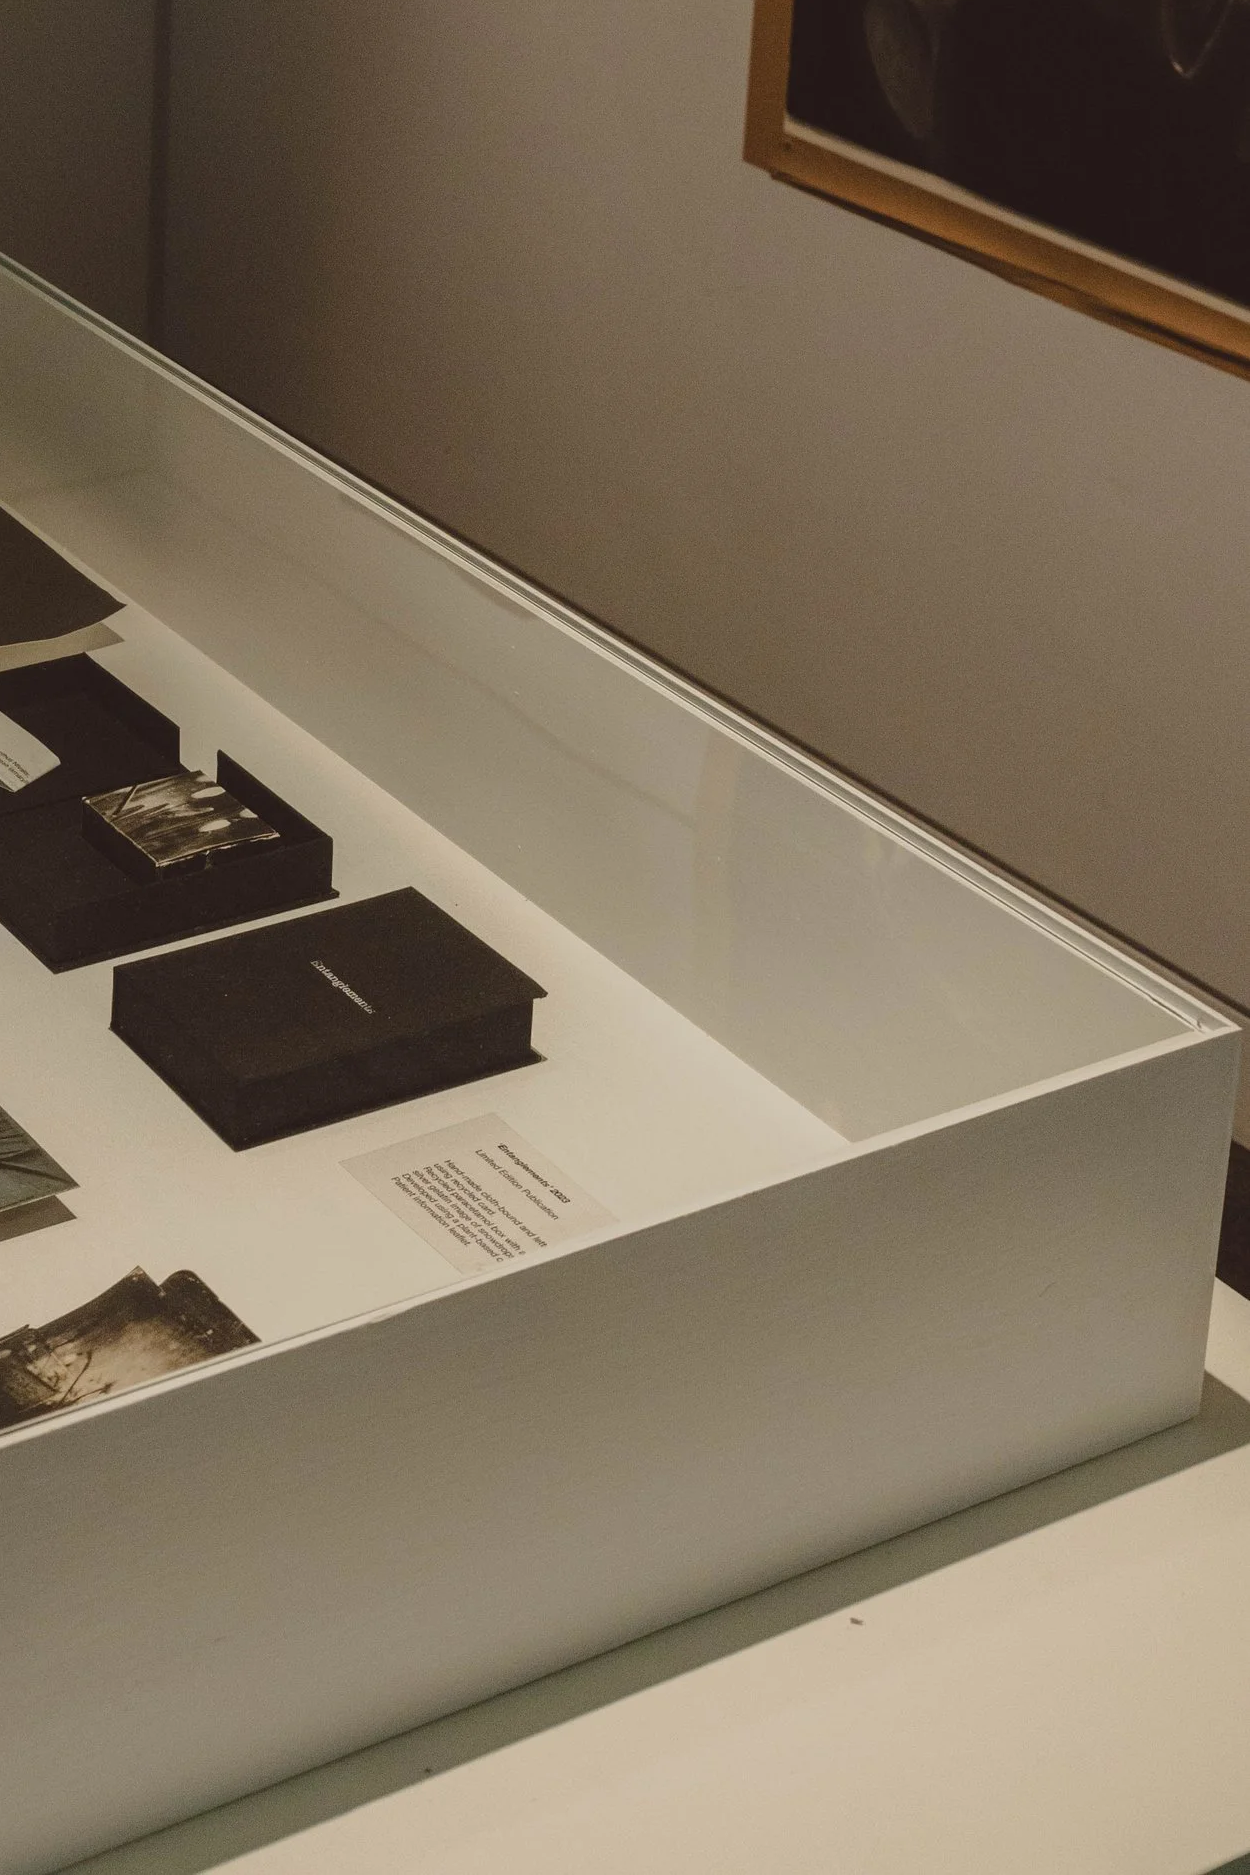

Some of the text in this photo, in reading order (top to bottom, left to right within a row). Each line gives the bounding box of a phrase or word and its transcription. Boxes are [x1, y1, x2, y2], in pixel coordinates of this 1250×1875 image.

[391, 1177, 416, 1197] Patient
[413, 1196, 450, 1228] information
[402, 1173, 438, 1203] Developed
[435, 1203, 454, 1219] using
[456, 1224, 499, 1257] plant-based
[412, 1170, 431, 1184] silver
[428, 1185, 452, 1203] gelatin
[450, 1204, 472, 1221] image
[423, 1166, 455, 1192] Recycled
[450, 1192, 494, 1226] paracetamol
[491, 1226, 506, 1238] box
[505, 1238, 520, 1250] with
[434, 1163, 453, 1179] using
[451, 1179, 481, 1202] recycled
[444, 1160, 482, 1192] Hand-made
[481, 1192, 522, 1225] cloth-bound
[519, 1226, 536, 1237] and
[475, 1149, 558, 1220] Limited Edition Publication
